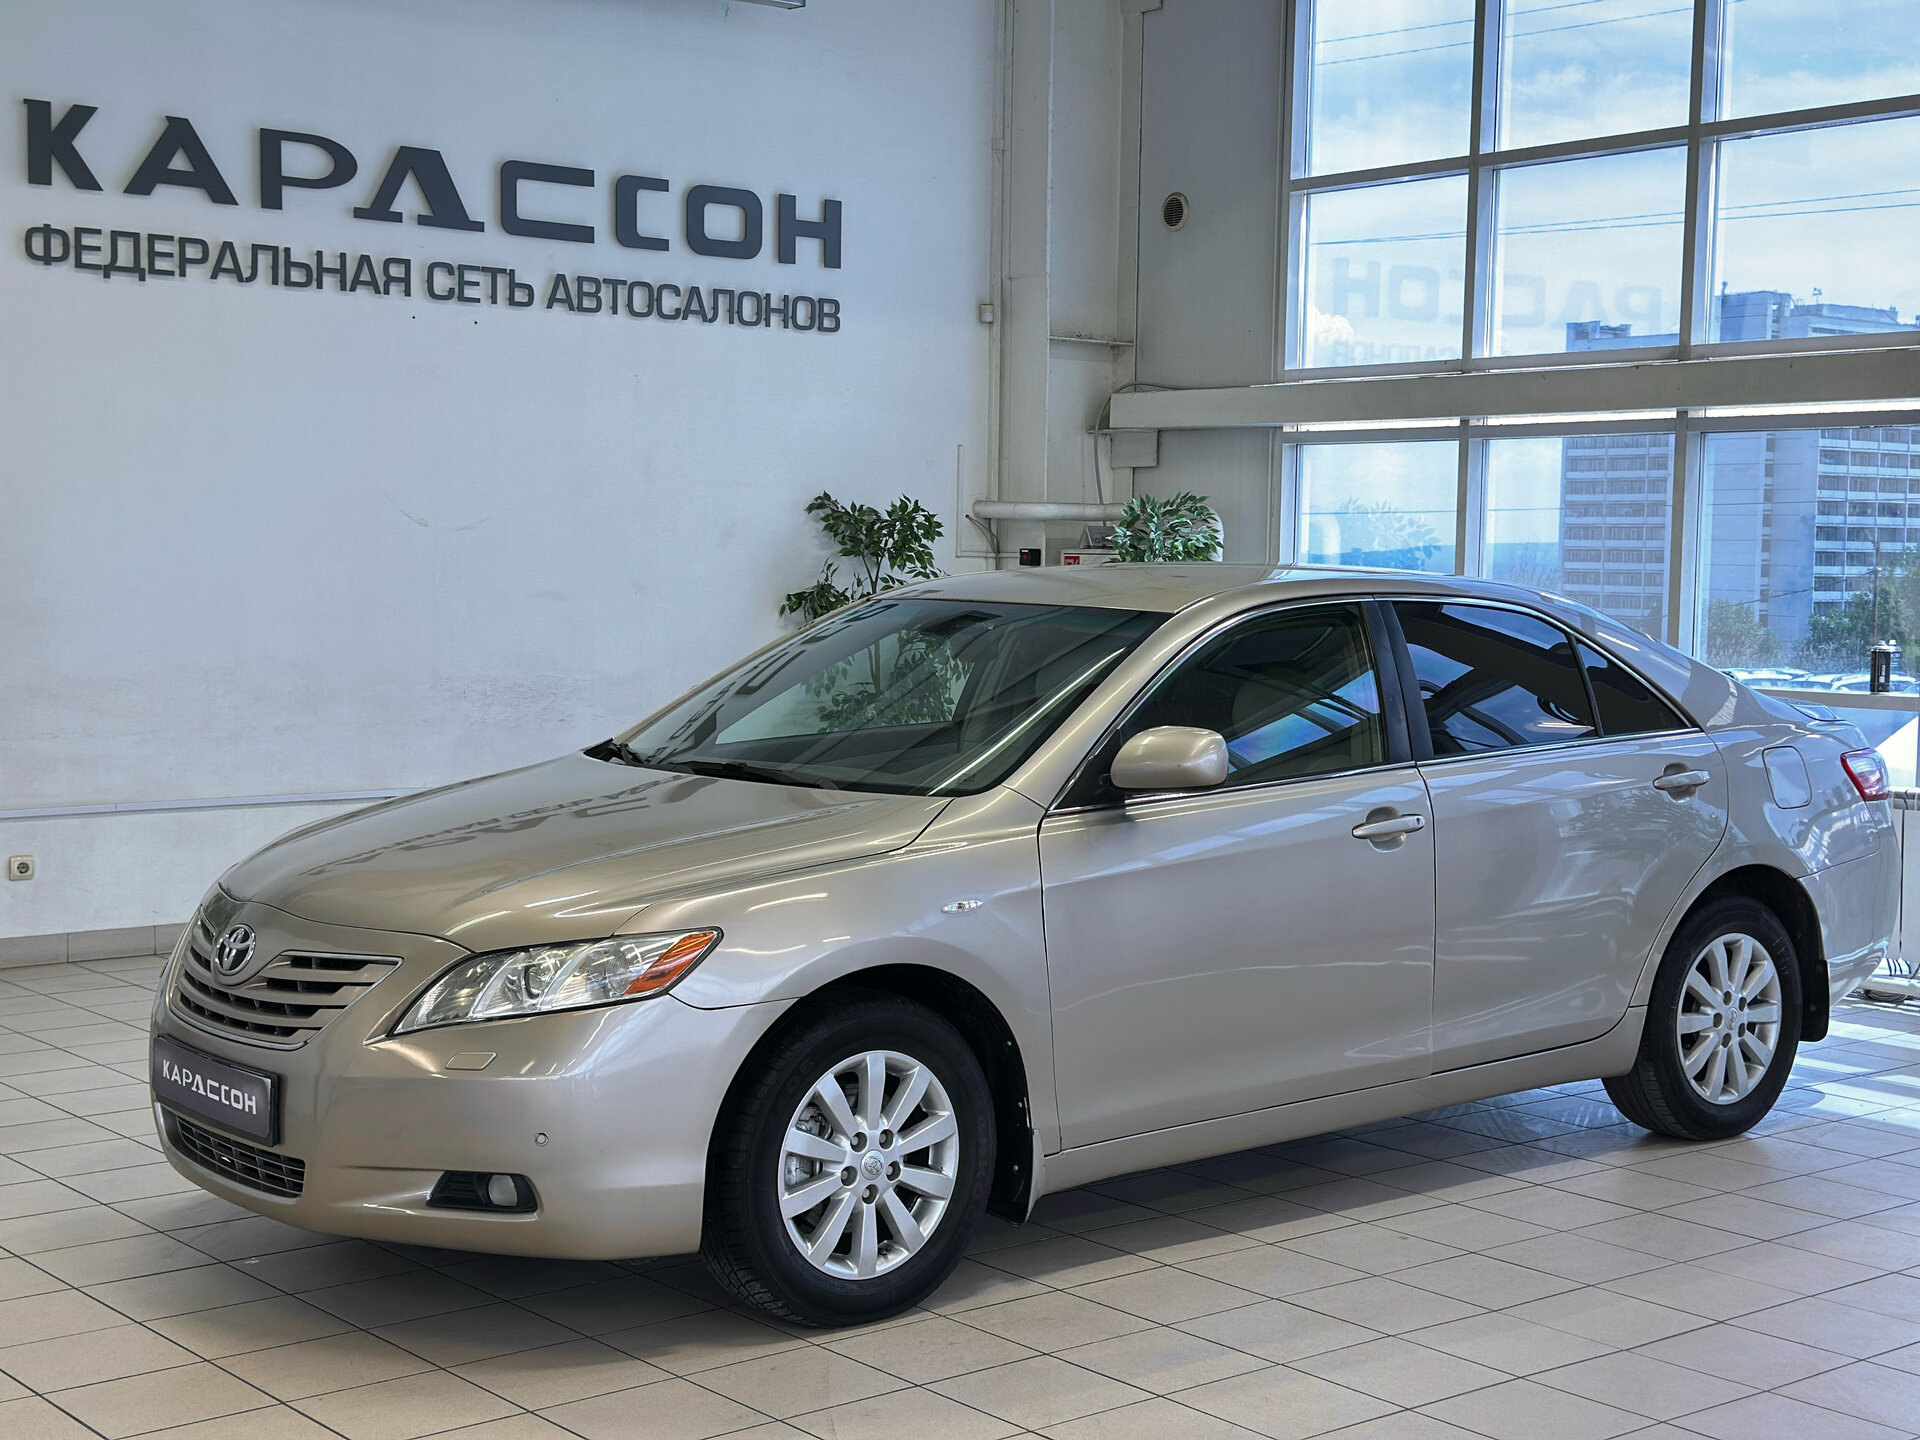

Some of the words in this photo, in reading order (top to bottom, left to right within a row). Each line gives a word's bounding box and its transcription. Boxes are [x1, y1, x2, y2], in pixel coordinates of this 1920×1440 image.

[22, 98, 842, 270] КАРАССОН
[24, 223, 412, 298] ФЕДЕРАЛЬНАЯ
[426, 261, 535, 308] СЕТЬ
[546, 273, 841, 333] АВТОСАЛОНОВ
[162, 1059, 257, 1115] КАРАССОН
